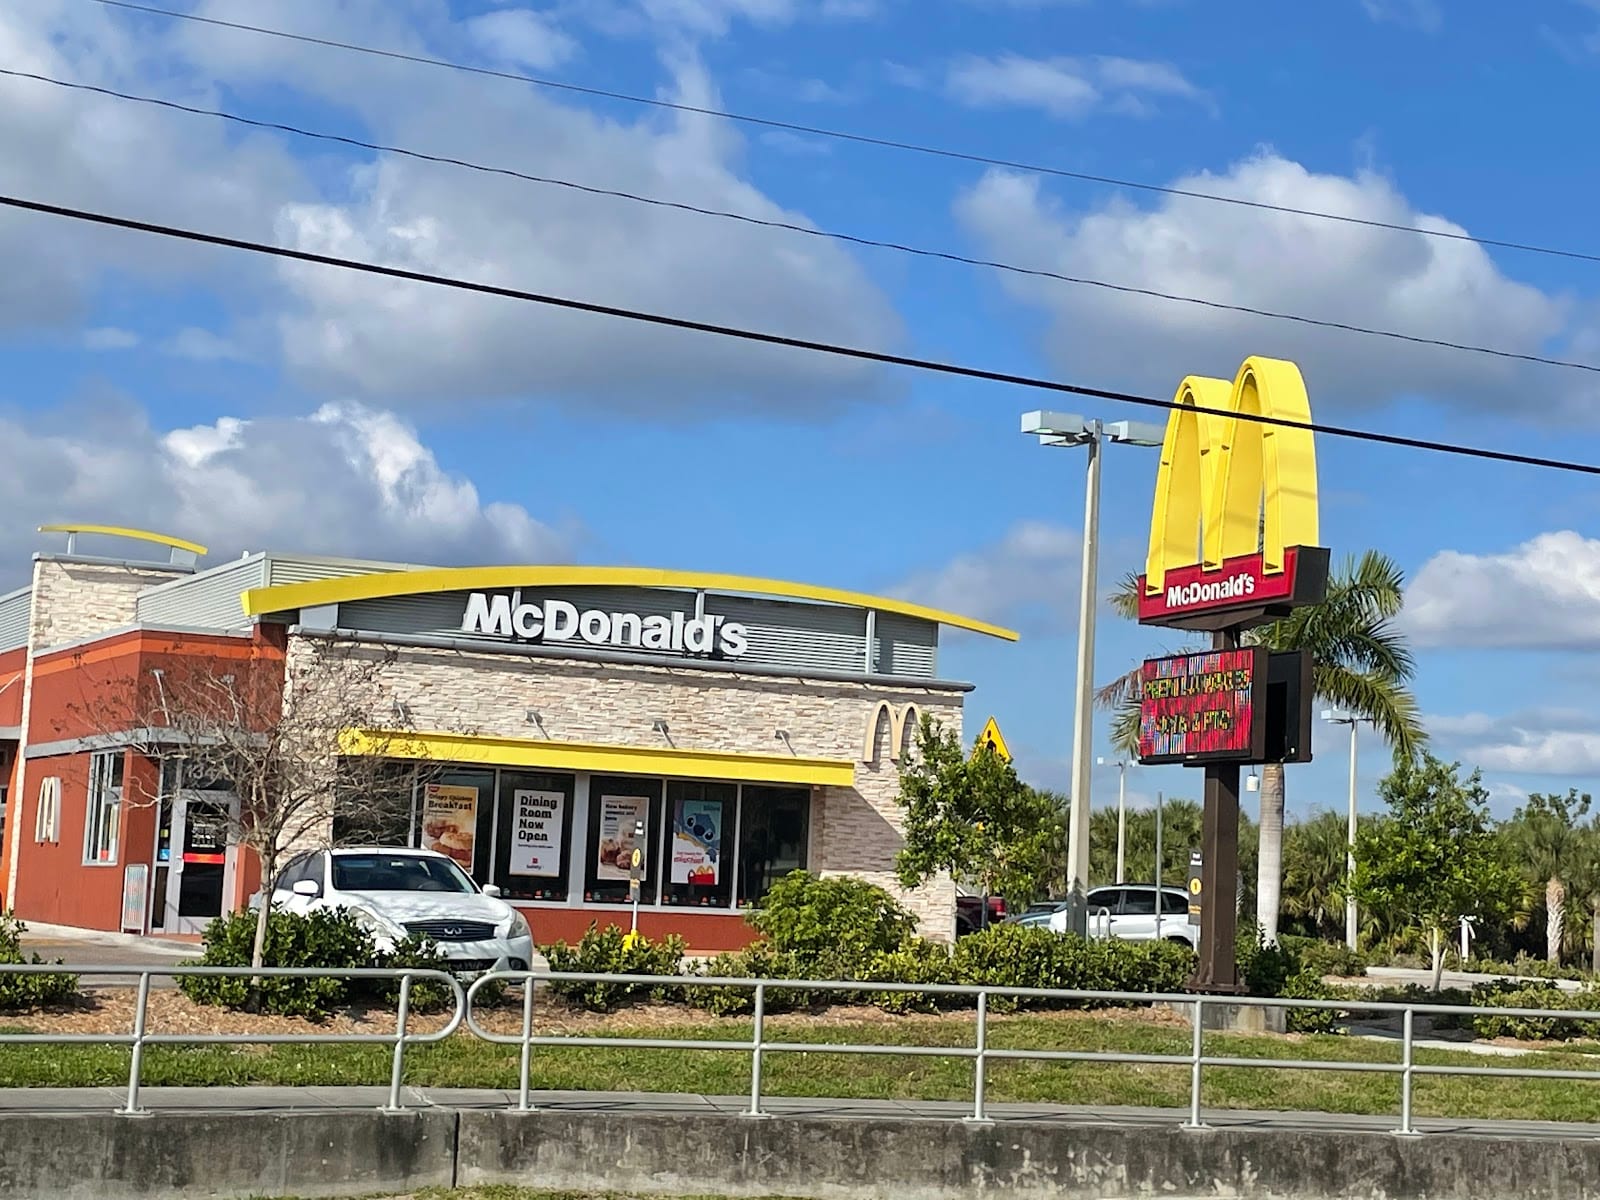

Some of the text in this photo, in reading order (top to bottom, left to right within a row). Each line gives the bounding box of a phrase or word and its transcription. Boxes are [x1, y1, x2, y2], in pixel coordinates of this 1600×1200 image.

[1166, 572, 1255, 608] McDonald's
[460, 592, 749, 656] McDonald's
[428, 800, 473, 811] Breakfast
[520, 795, 558, 810] Dining
[519, 807, 552, 819] Room
[518, 819, 544, 829] Now
[518, 830, 548, 842] Open
